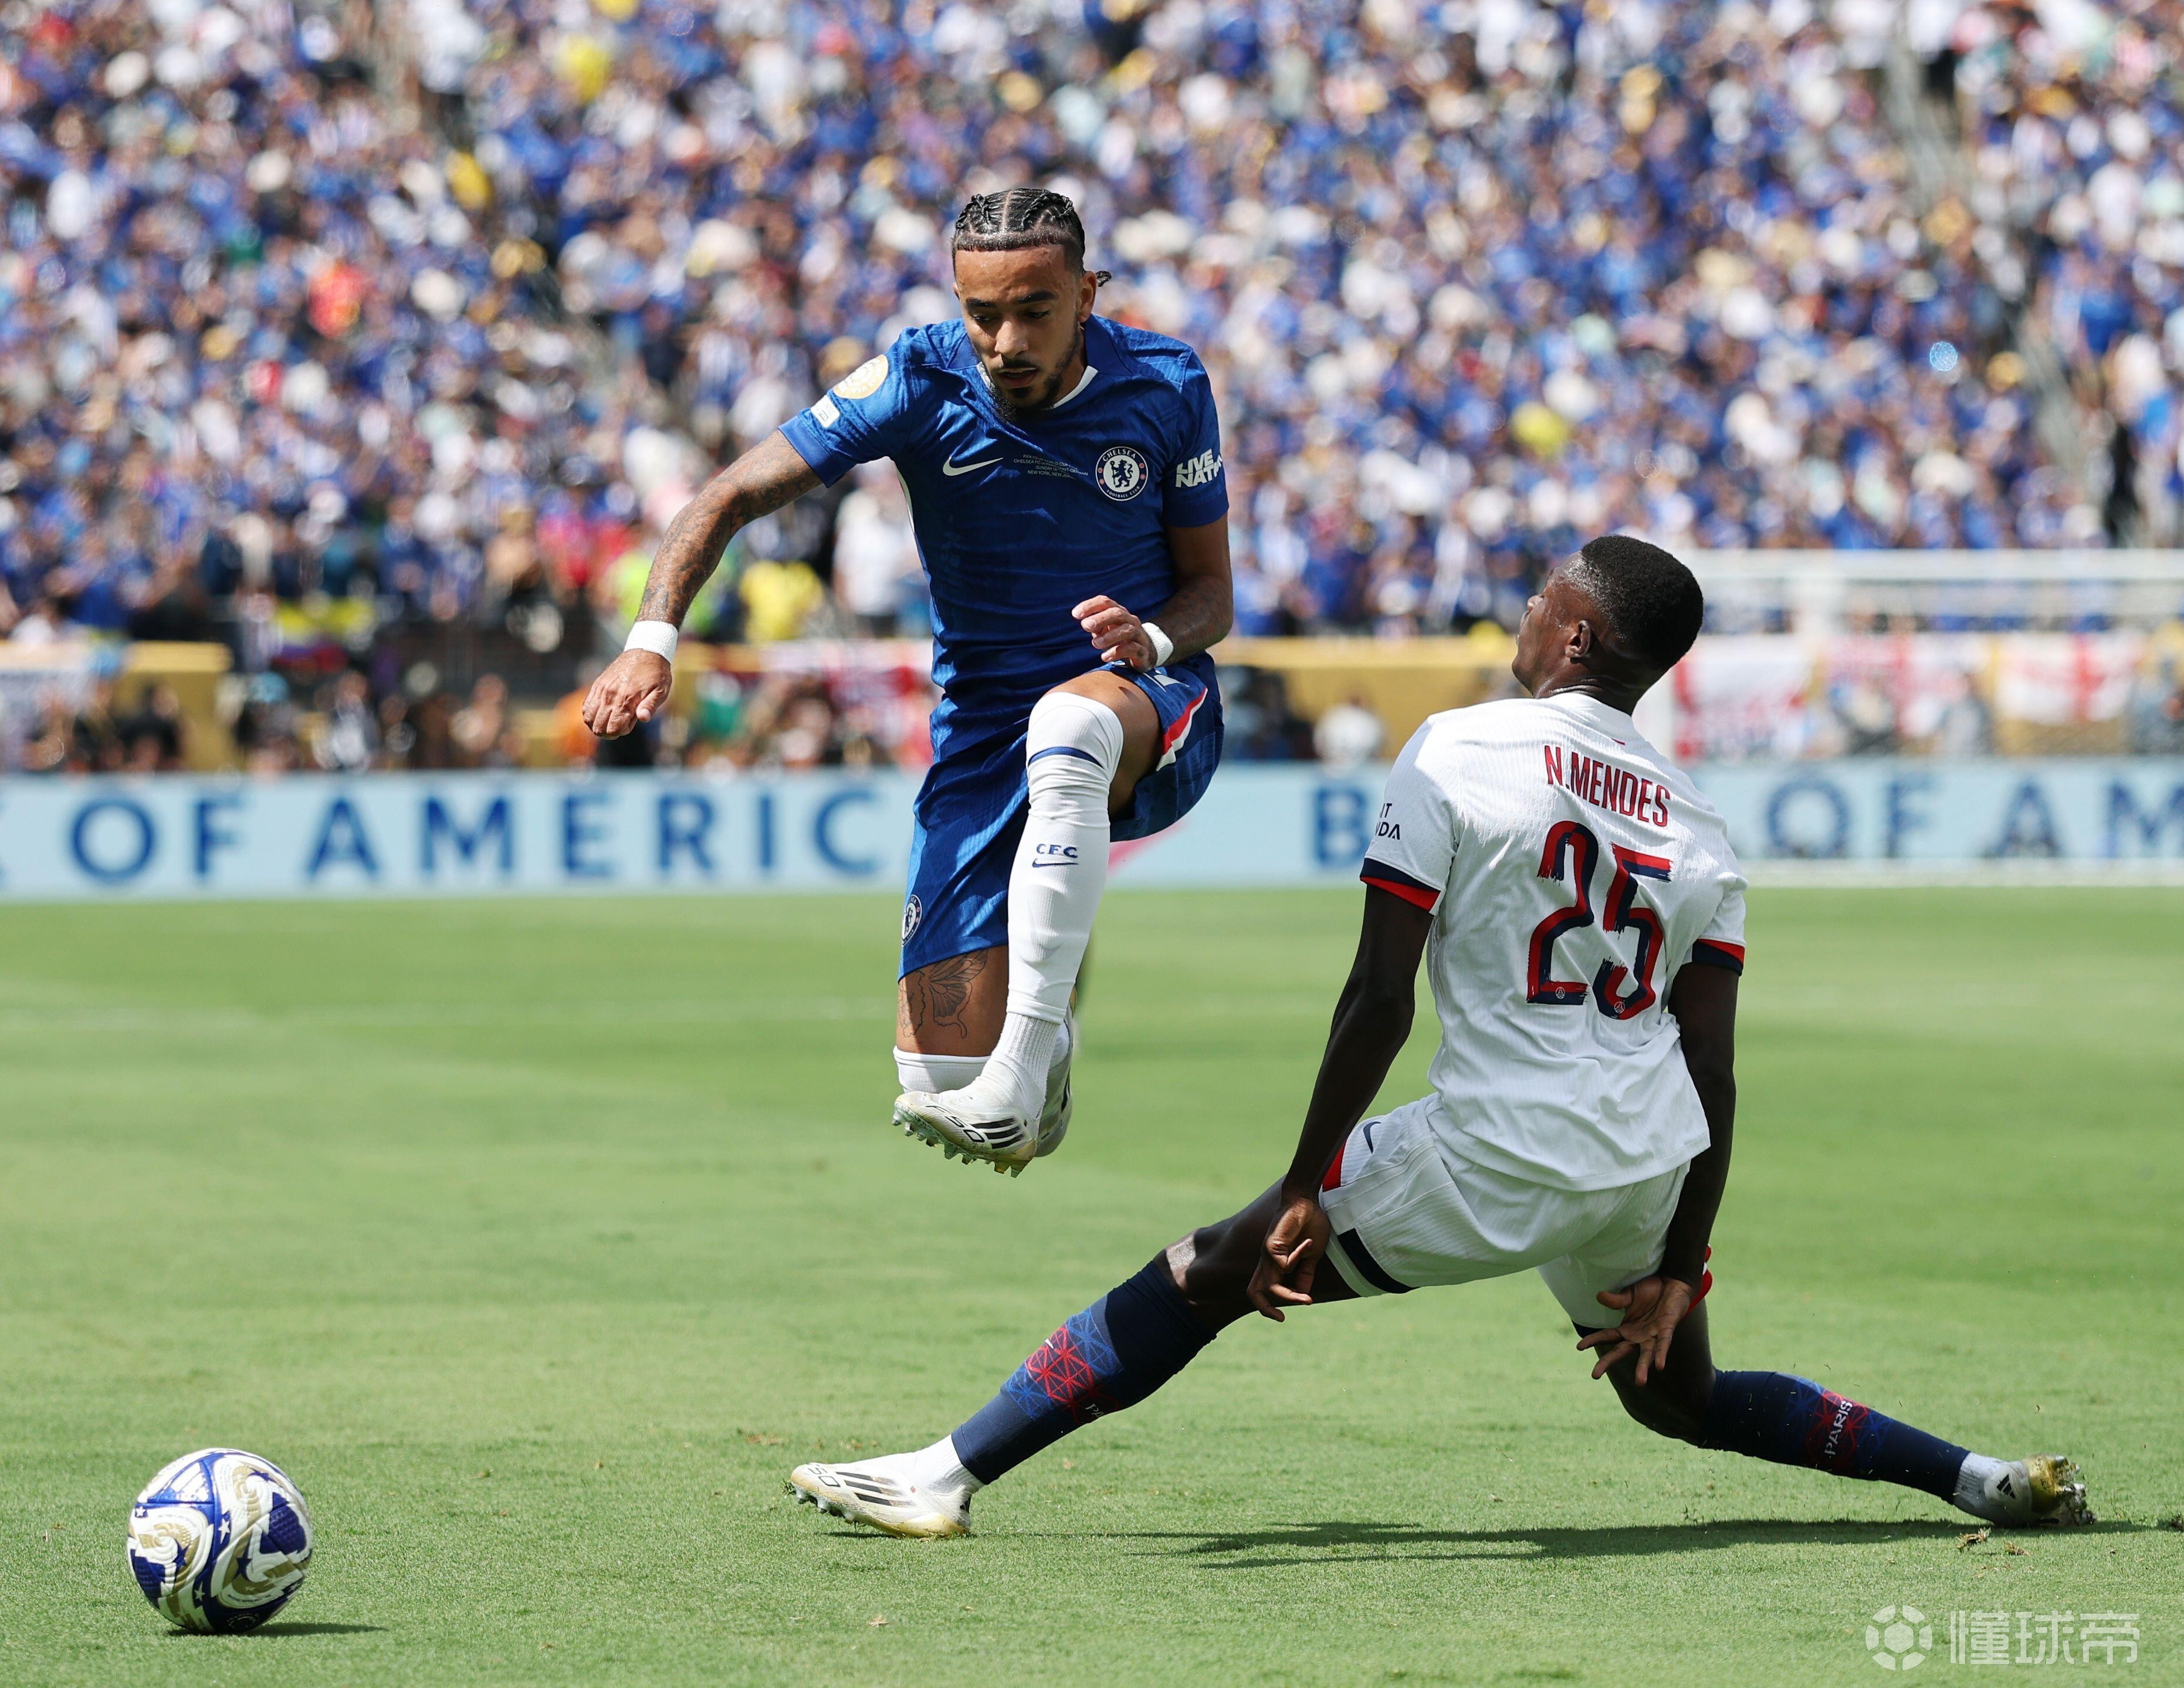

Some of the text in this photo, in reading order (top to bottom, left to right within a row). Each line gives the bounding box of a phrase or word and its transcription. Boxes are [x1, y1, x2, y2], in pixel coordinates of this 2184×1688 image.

[1103, 449, 1136, 462] CHELSEA
[1177, 449, 1214, 474] LIVE
[1106, 486, 1140, 498] FOOTBALL CLUB
[1544, 745, 1671, 827] N.MENDES
[1765, 776, 1936, 860] OF
[69, 796, 245, 882] OF
[1036, 843, 1078, 858] CFC
[1526, 820, 1673, 1020] 25
[1824, 1400, 1853, 1456] PARIS
[807, 1464, 841, 1487] 50
